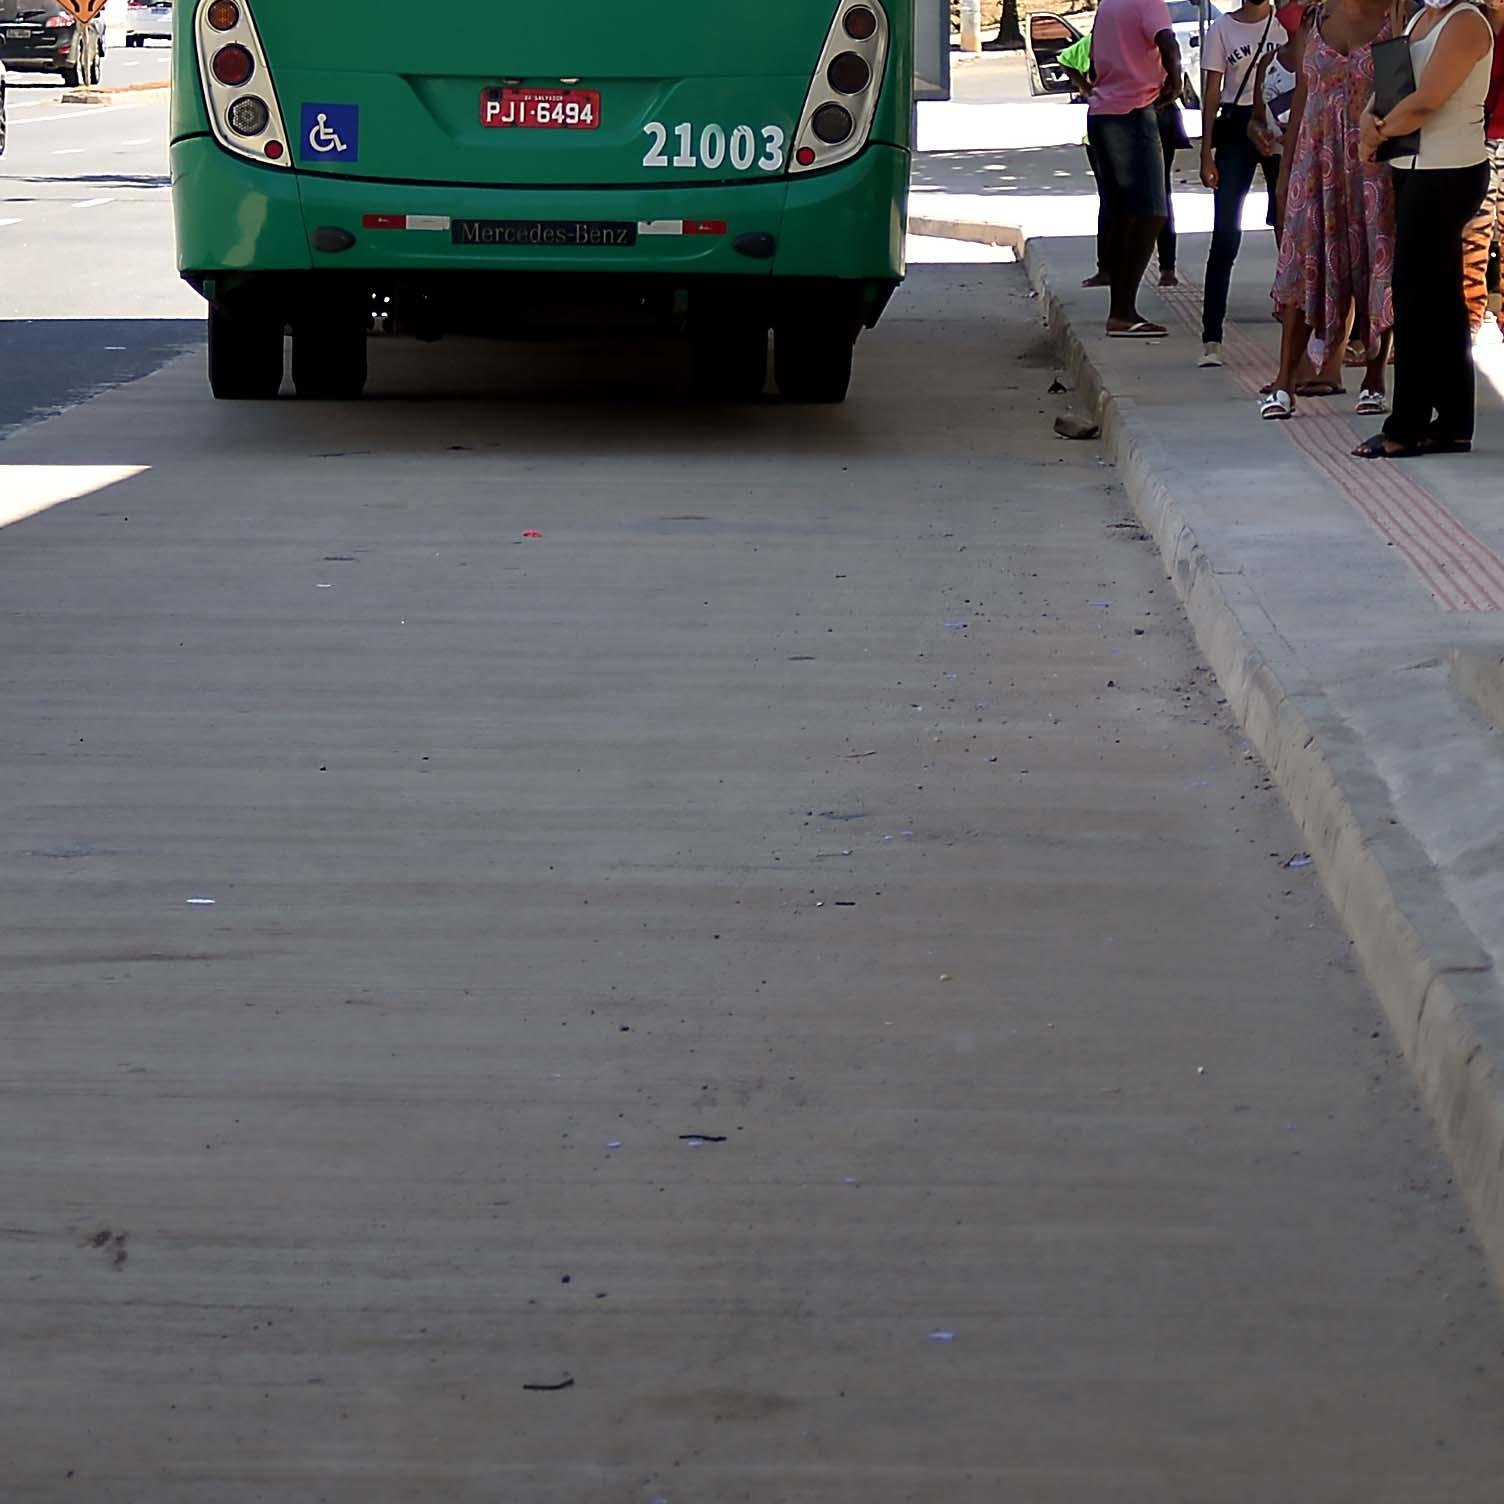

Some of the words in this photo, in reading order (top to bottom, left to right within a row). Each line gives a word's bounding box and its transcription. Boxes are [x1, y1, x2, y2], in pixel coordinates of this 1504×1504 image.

[1227, 45, 1251, 65] NEW
[643, 121, 784, 171] 21003
[460, 222, 629, 244] Mercedes-Benz
